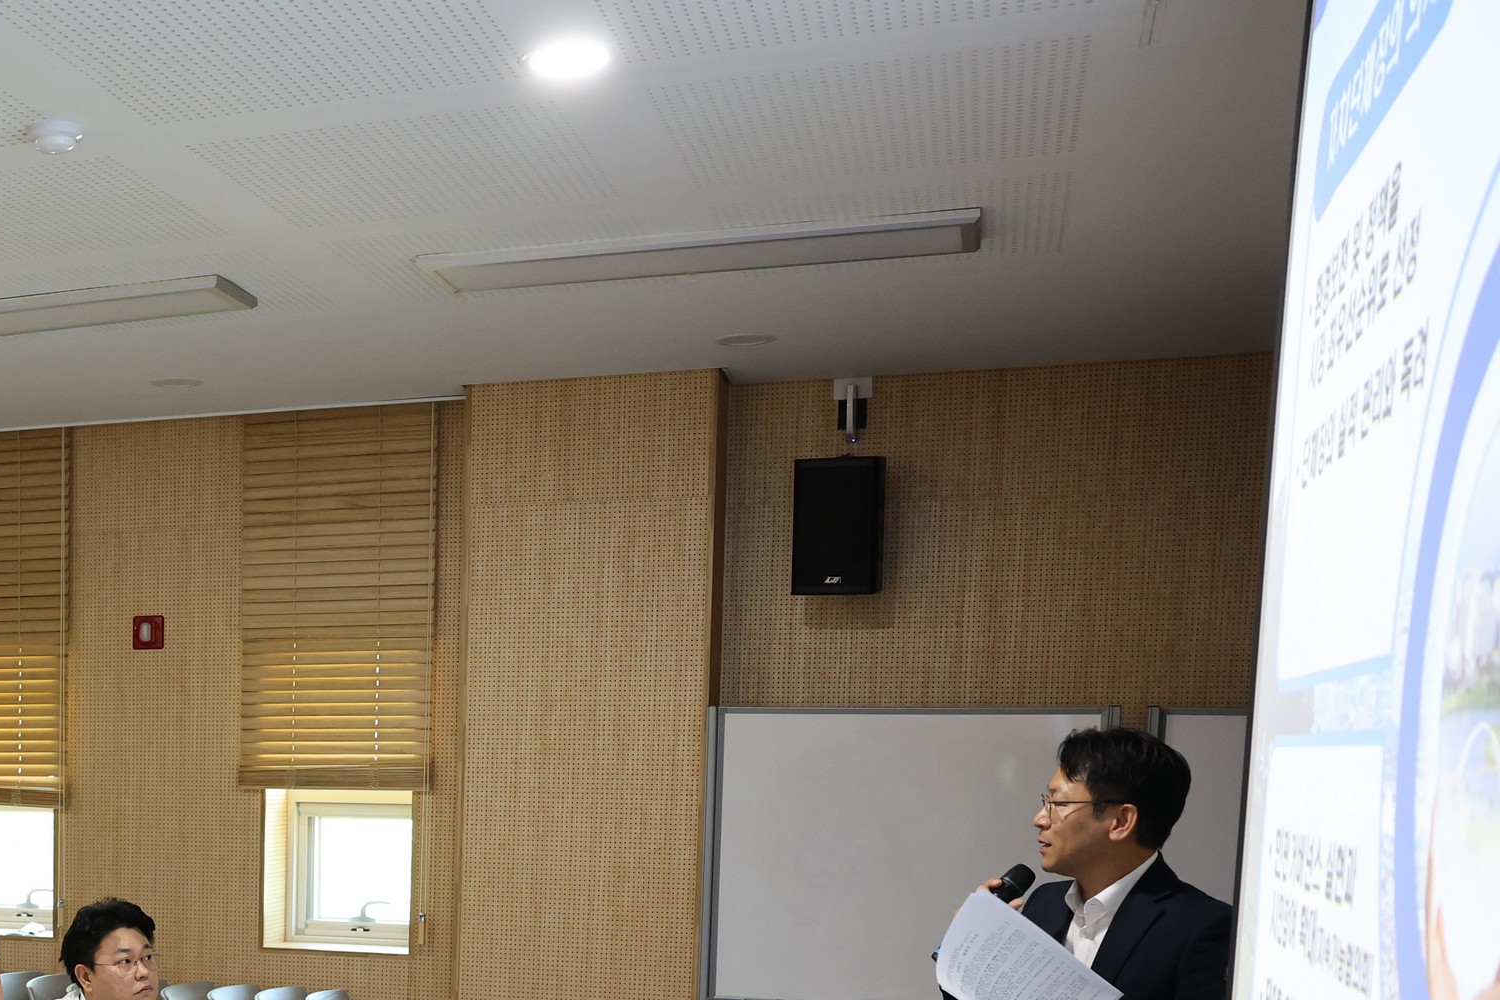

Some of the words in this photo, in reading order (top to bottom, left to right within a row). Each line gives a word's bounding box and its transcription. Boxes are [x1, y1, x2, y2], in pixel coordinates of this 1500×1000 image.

[1351, 211, 1364, 279] 및
[1366, 160, 1402, 261] 정책을
[1308, 327, 1326, 391] 시정
[1327, 249, 1390, 371] 최우선순위로
[1393, 206, 1422, 301] 선정
[1302, 408, 1336, 490] 단체장의
[1338, 387, 1359, 460] 실적
[1361, 347, 1398, 440] 관리와
[1401, 316, 1430, 403] 독려
[1270, 889, 1298, 951] 시민참여
[1325, 840, 1358, 909] 실현과
